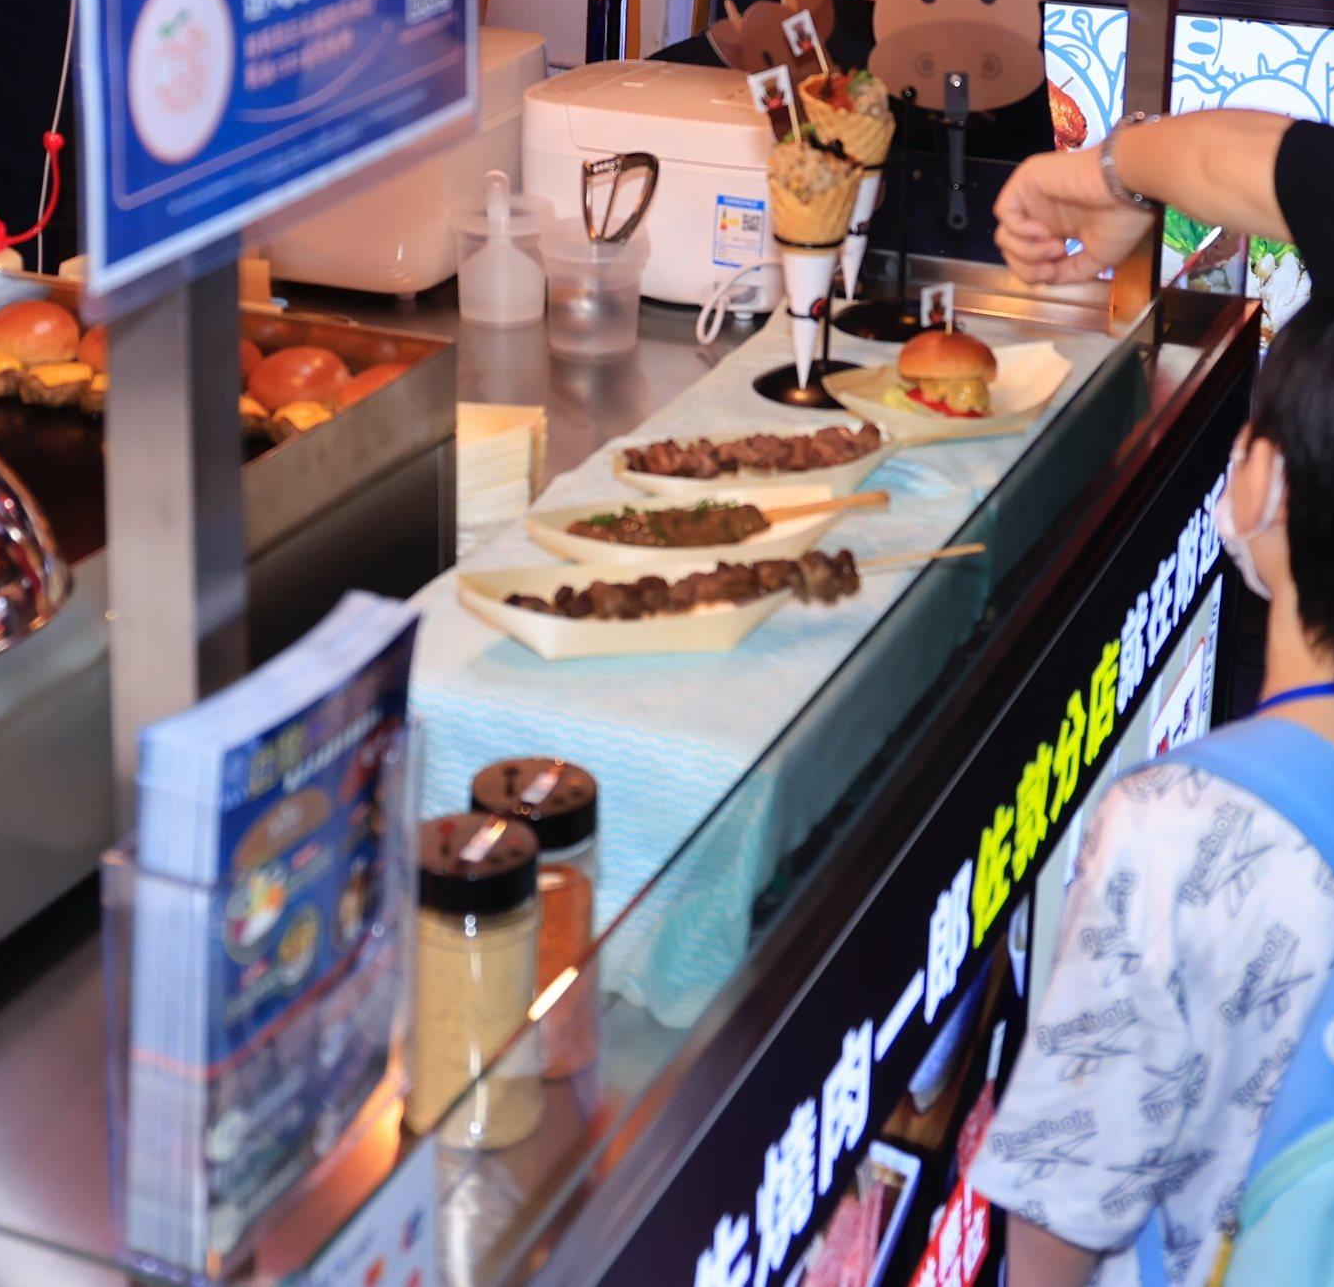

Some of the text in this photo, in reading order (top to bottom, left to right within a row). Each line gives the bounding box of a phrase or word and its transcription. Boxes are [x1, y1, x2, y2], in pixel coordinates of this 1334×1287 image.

[1179, 801, 1244, 905] Reebok
[1037, 999, 1133, 1053] Reebok
[991, 1111, 1095, 1154] Reebok
